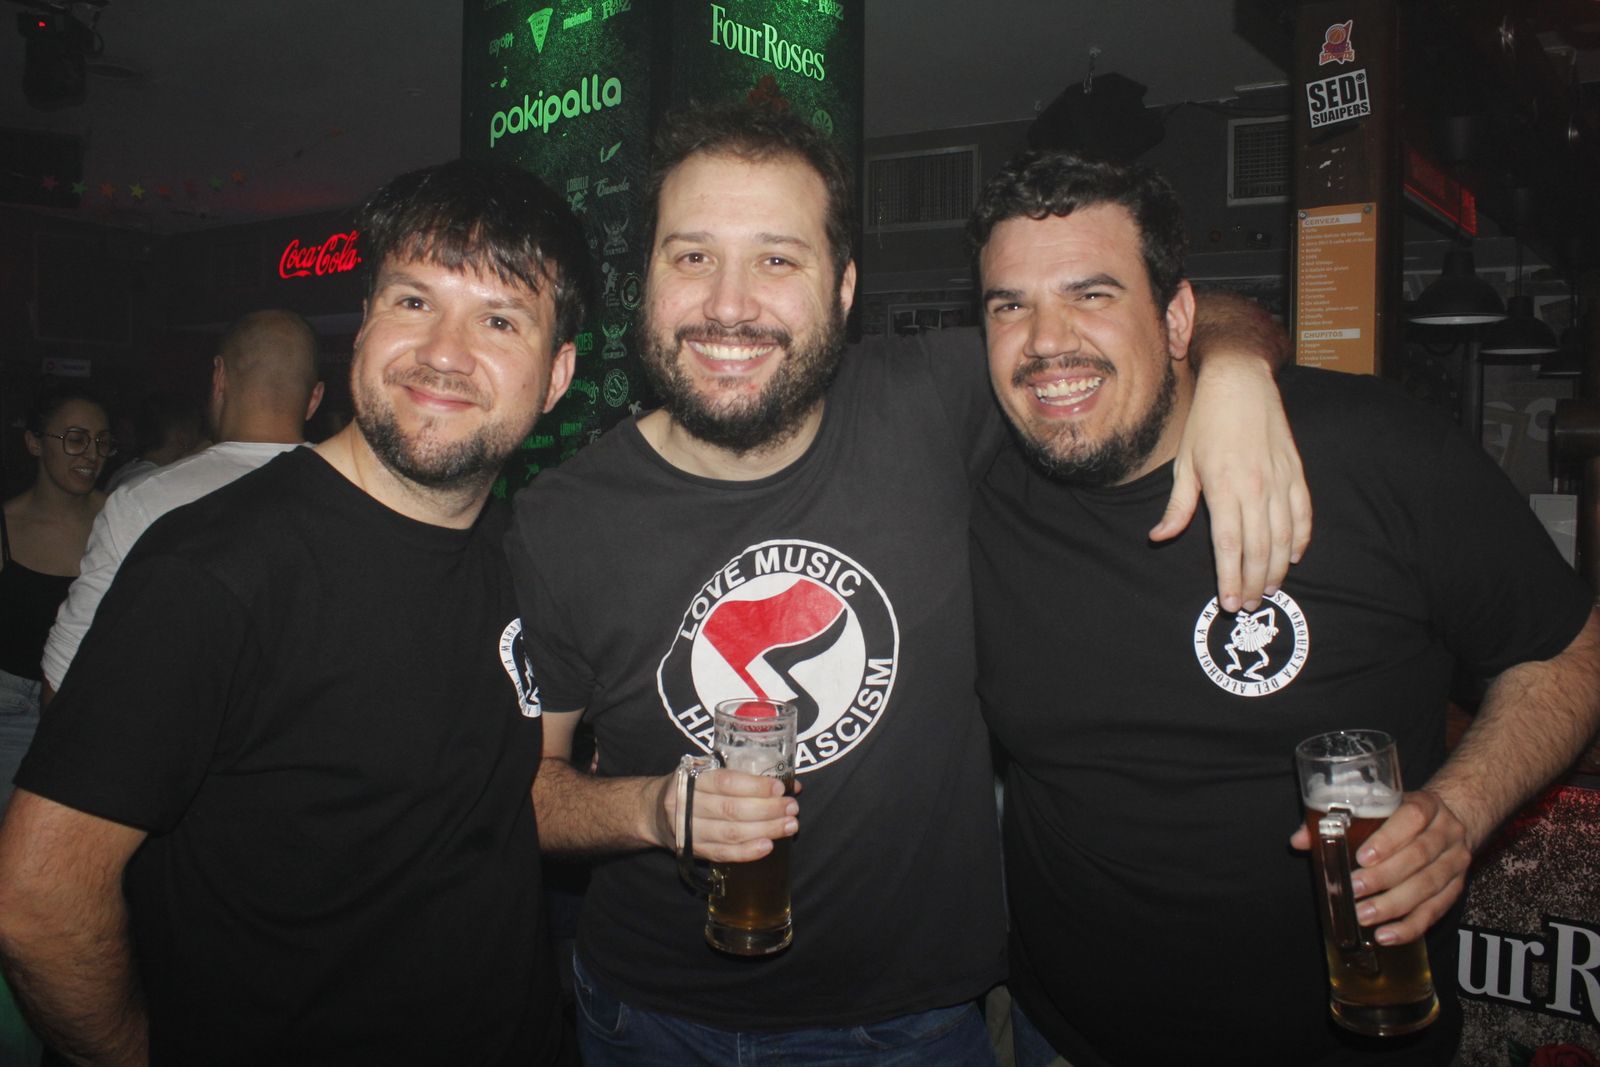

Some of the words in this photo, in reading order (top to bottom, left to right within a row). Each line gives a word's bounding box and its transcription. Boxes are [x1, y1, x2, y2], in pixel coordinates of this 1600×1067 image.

[490, 74, 622, 148] pakipalla
[1312, 102, 1368, 125] SUAIPERS
[1304, 217, 1340, 226] CERVEZA
[1303, 331, 1343, 339] CHUPITOS
[680, 560, 746, 640] LOVE
[755, 546, 862, 598] MUSIC
[1199, 651, 1247, 694] ALCOHOL
[1255, 678, 1280, 694] DEL
[677, 703, 715, 749] HA
[795, 657, 893, 768] ASCISM
